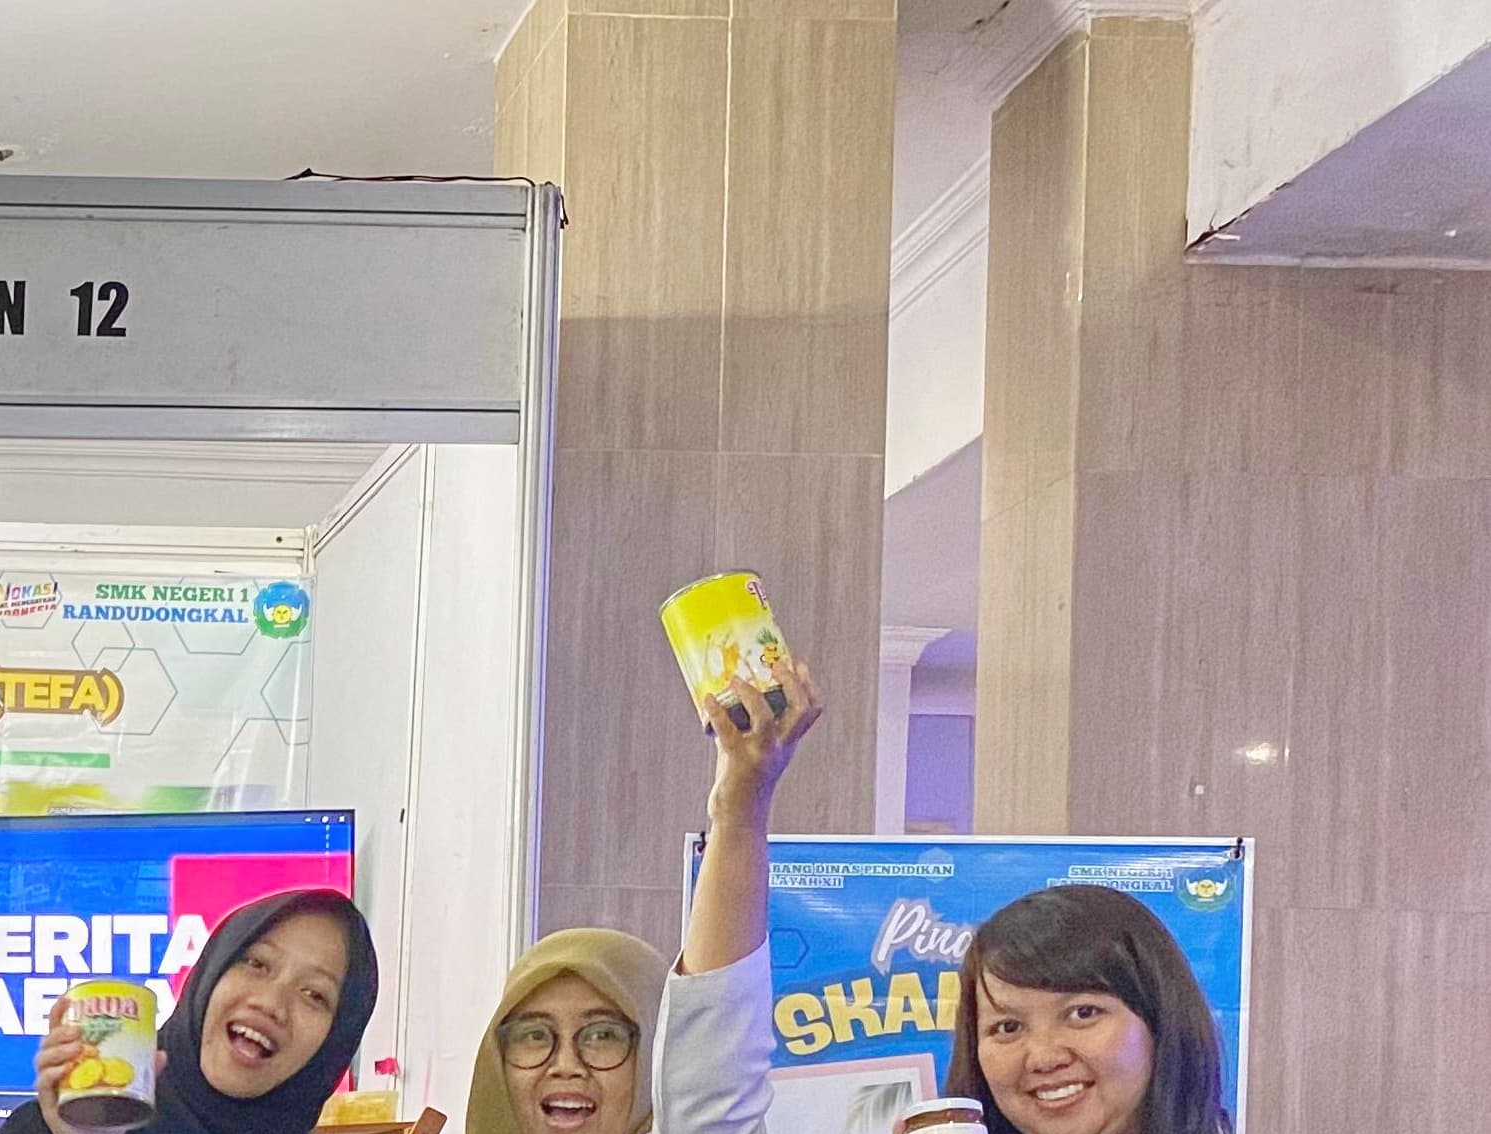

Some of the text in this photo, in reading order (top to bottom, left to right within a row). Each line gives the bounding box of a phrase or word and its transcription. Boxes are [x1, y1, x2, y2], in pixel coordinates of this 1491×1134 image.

[69, 280, 130, 338] 12
[95, 583, 249, 603] SMK NEGERI 1
[62, 604, 249, 624] RANDUDONGKAL
[814, 863, 861, 875] DINAS
[863, 864, 954, 876] PENDIDIKAN
[1069, 866, 1105, 877] SMK
